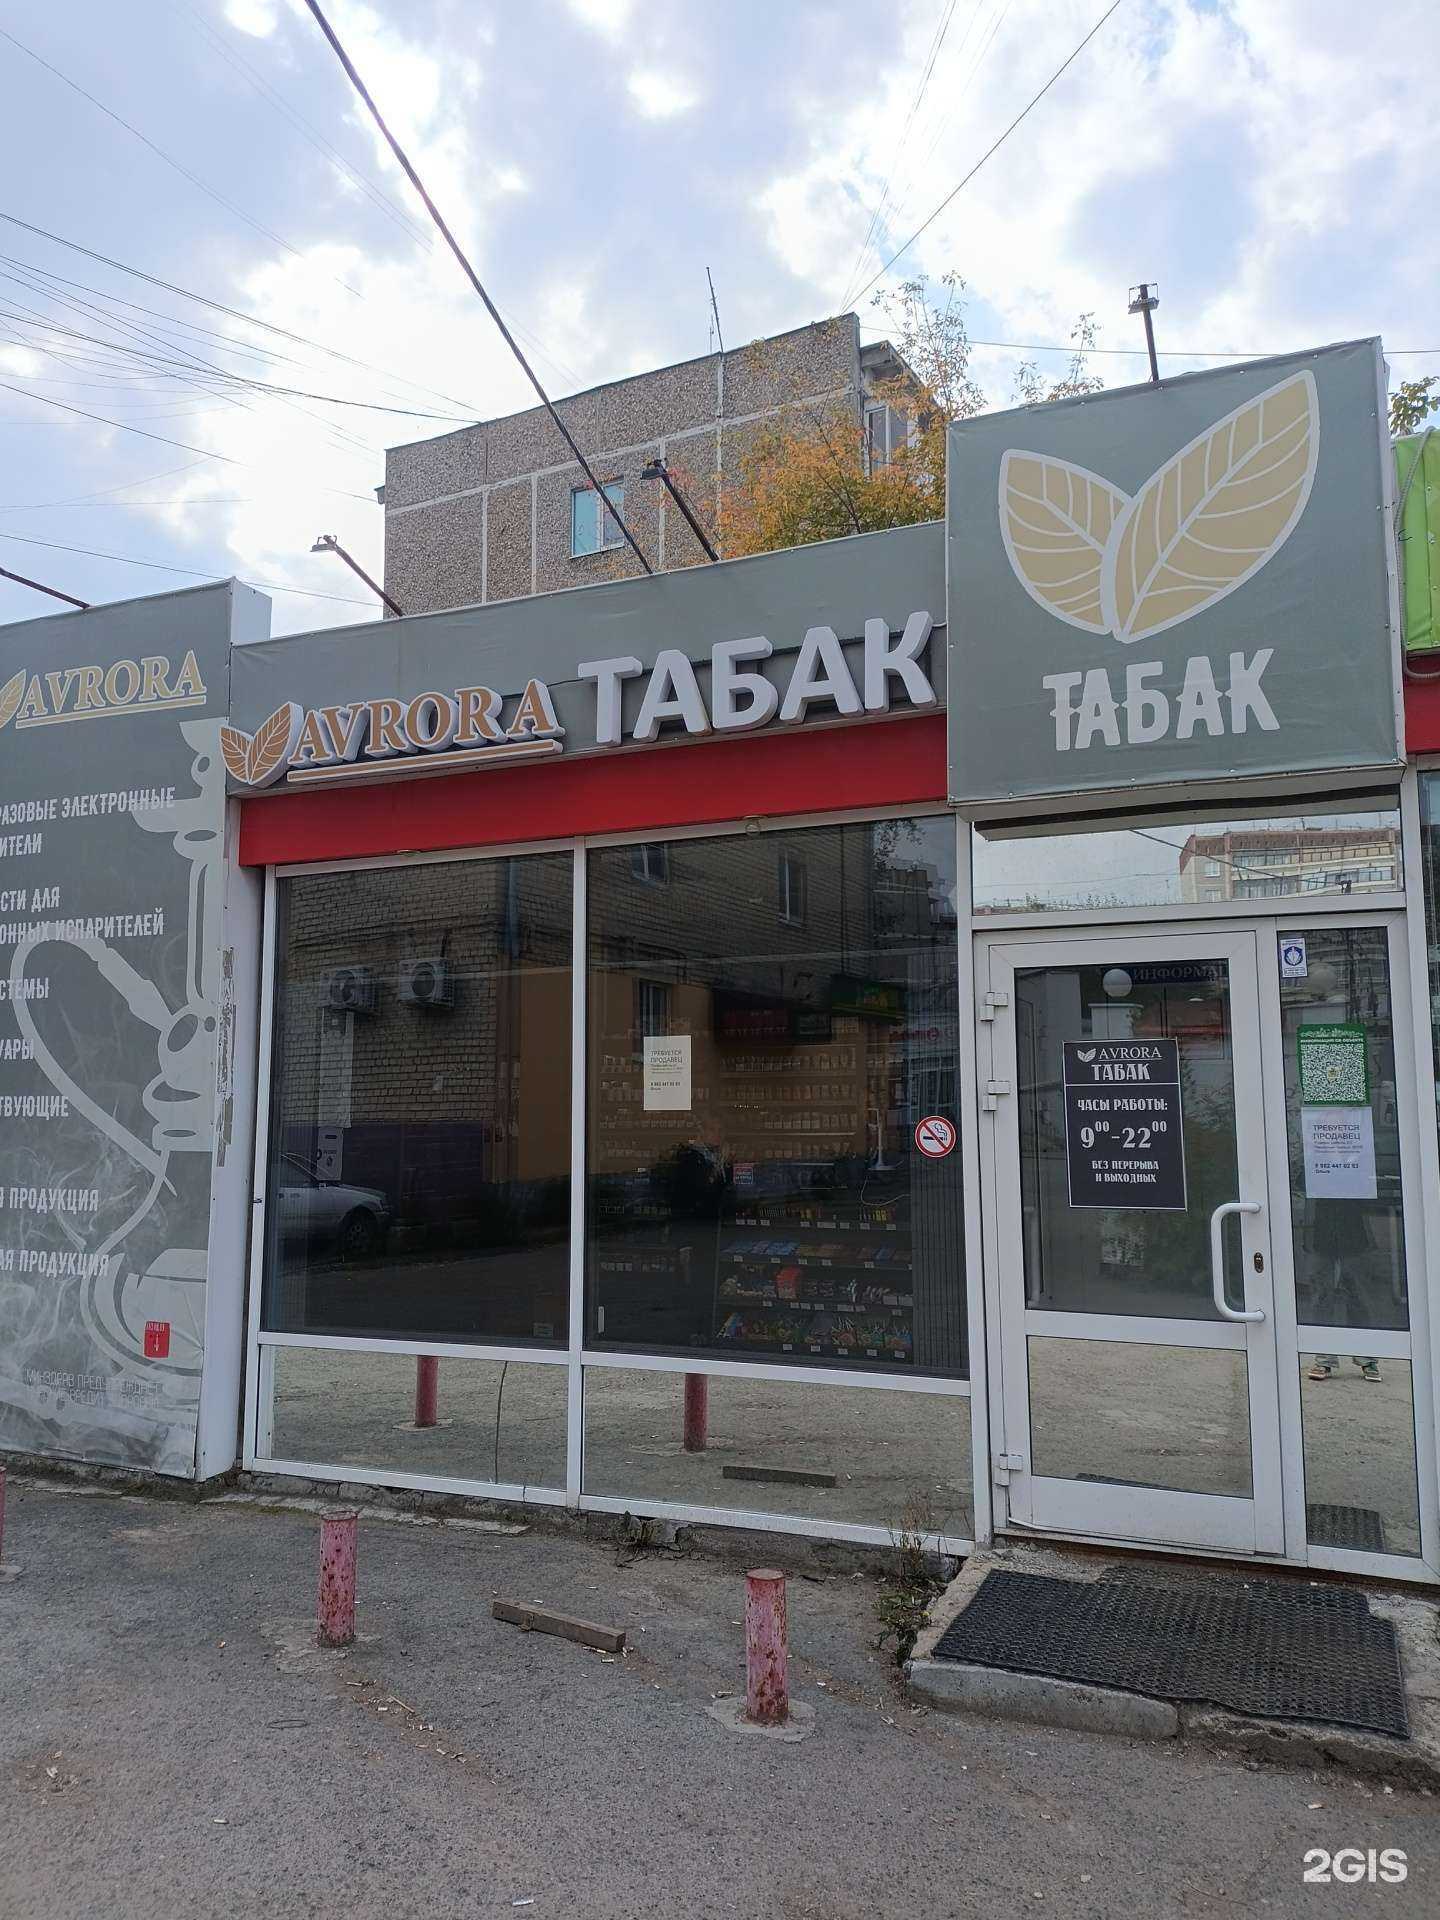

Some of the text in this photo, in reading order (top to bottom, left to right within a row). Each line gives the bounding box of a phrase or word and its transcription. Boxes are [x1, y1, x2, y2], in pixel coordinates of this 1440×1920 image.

[16, 649, 208, 718] AVRORA
[577, 610, 939, 746] ТАБАК
[1042, 648, 1280, 751] ТАБАК
[286, 677, 567, 767] AVRORA
[0, 787, 176, 825] АЗОВЫЕ ЭЛЕКТРОННЫЕ
[31, 886, 60, 913] ДЛЯ
[55, 907, 164, 941] ИСПАРИТЕЛЕЙ
[1098, 1046, 1163, 1060] AVRORA
[1091, 1062, 1151, 1081] ТАБАК
[1077, 1098, 1168, 1111] ЧАСЫ РАБОТЫ:
[1313, 1132, 1361, 1141] ПРОДАВЕЦ
[1092, 1160, 1160, 1170] БЕЗ ПЕРЕРЫВА
[1095, 1173, 1157, 1183] И ВЫХОДНЫХ
[9, 1187, 100, 1214] ПРОДУКЦИЯ
[18, 1249, 110, 1278] ПРОДУКЦИЯ
